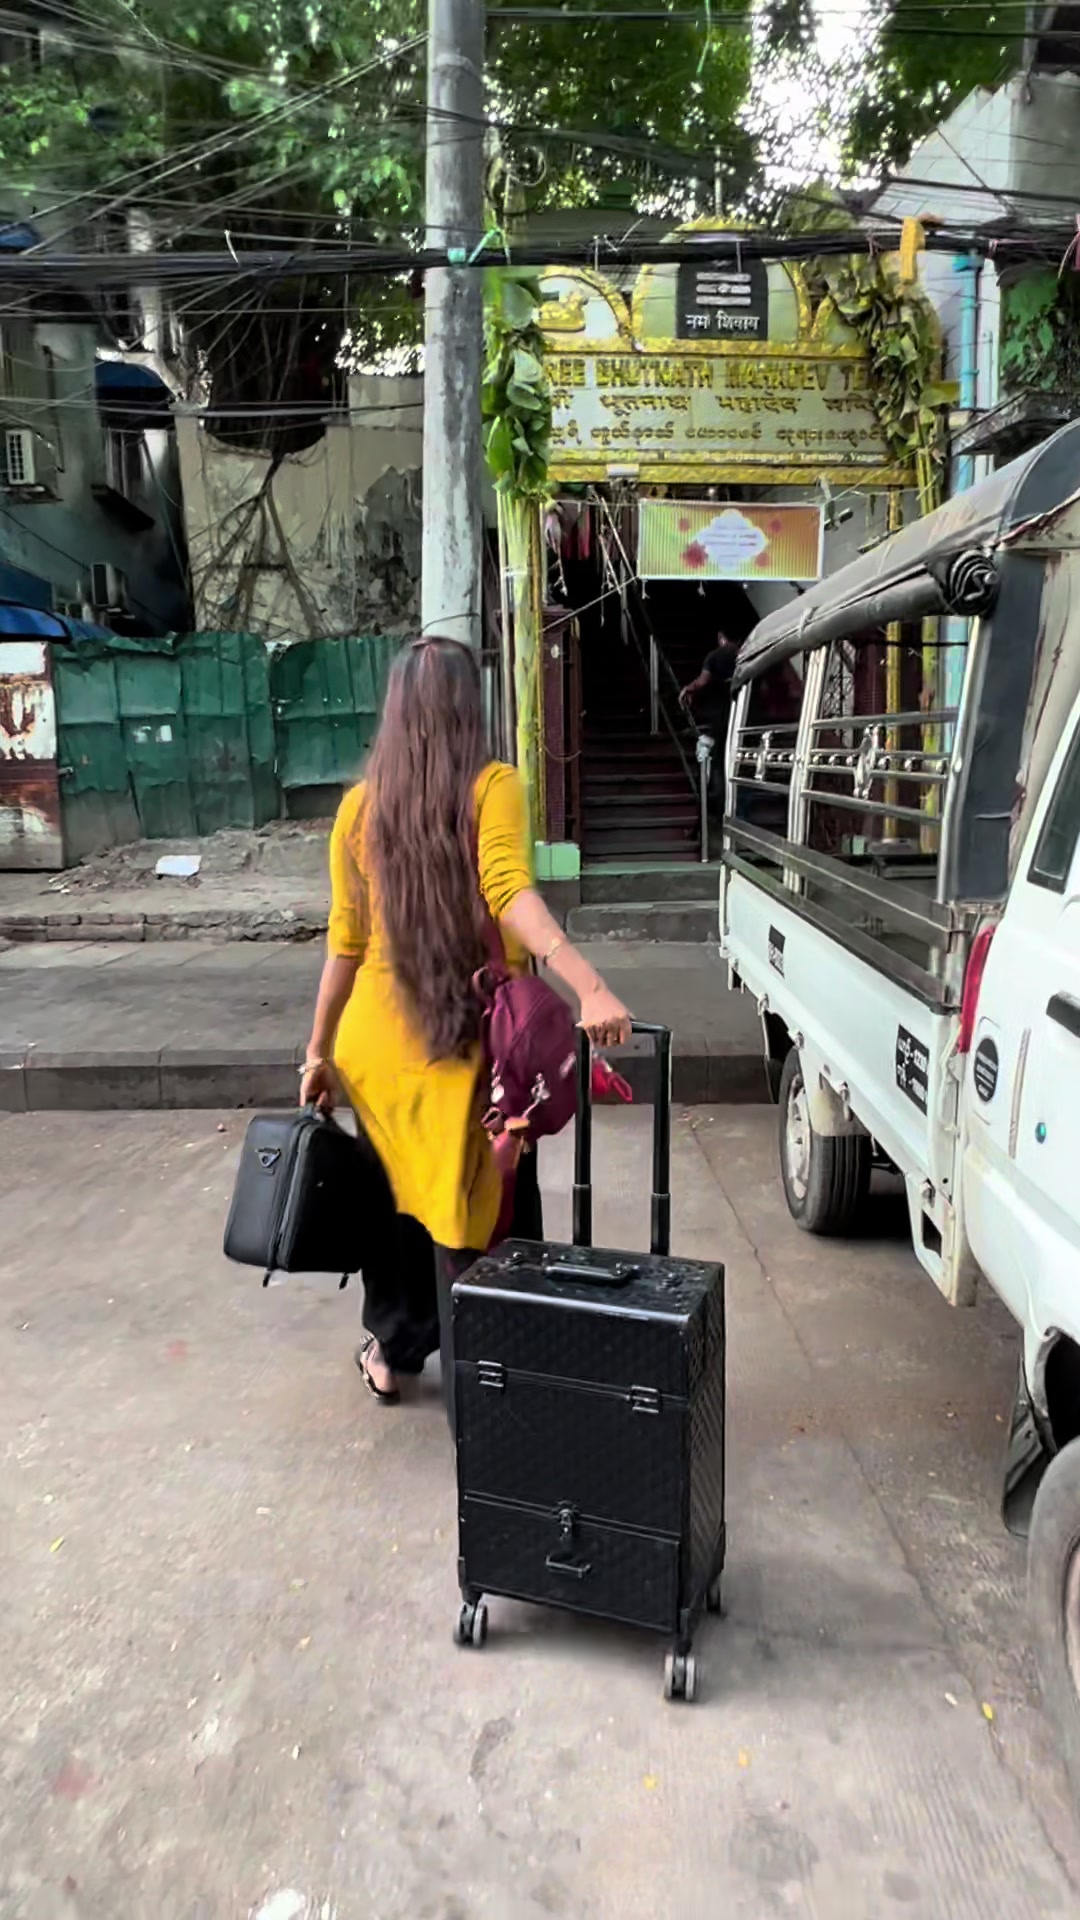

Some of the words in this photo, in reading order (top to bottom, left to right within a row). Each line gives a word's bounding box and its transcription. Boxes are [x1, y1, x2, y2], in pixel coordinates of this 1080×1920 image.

[716, 309, 760, 331] शिवाय
[545, 359, 586, 386] REE
[725, 361, 828, 390] MAHADEV
